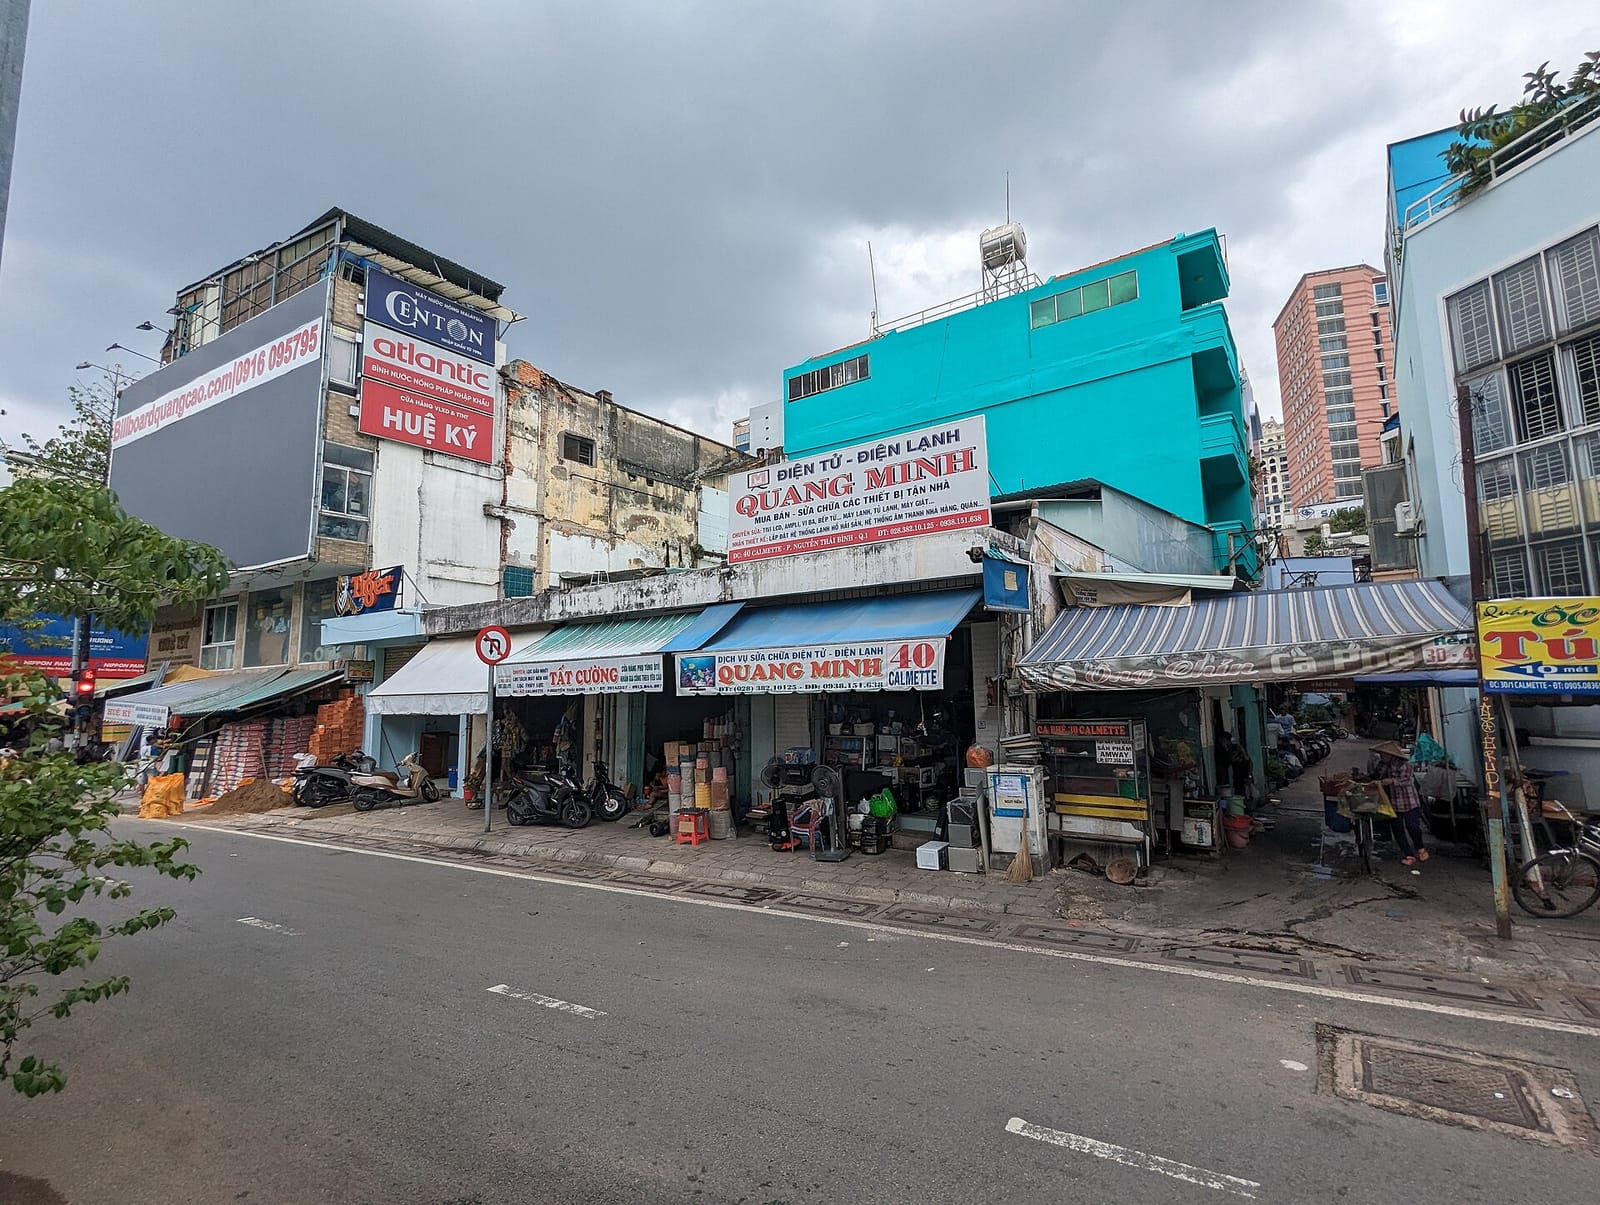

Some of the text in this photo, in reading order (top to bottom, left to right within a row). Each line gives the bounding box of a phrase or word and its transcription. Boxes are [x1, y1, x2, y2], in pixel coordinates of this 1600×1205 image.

[385, 290, 484, 347] CENTON
[268, 324, 318, 371] 095795
[373, 338, 490, 390] atlantic
[371, 364, 490, 407] BÌNH NƯỚC NÓNG PHÁP NHẬP KHẨU
[415, 398, 434, 410] HÀNG
[383, 406, 478, 449] HUỆ KÝ
[777, 428, 960, 481] ĐIỆN TỬ ĐIỆN LẠNH
[735, 446, 978, 518] QUANG MINH
[754, 480, 950, 525] MUA BÁN SỬA CHỮA CÁC THIẾT BỊ TẬN NHÀ
[904, 510, 924, 519] THANH
[926, 506, 938, 515] NHÀ
[820, 536, 836, 546] THÁI
[837, 534, 854, 543] BÌNH
[352, 570, 394, 608] Tiger
[1483, 606, 1536, 618] Quán
[718, 646, 884, 664] DỊCH VỤ SỬA CHỮA ĐIỆN TỬ ĐIỆN LẠNH
[890, 642, 936, 670] 40
[1426, 647, 1446, 662] 30
[1483, 628, 1600, 660] Tú
[550, 664, 619, 686] TẤT CƯỜNG
[718, 658, 884, 685] QUANG MINH
[888, 670, 937, 686] CALMETTE
[1520, 665, 1558, 674] 10
[1514, 681, 1549, 689] CALMETTE
[1079, 726, 1126, 735] CALMETTE
